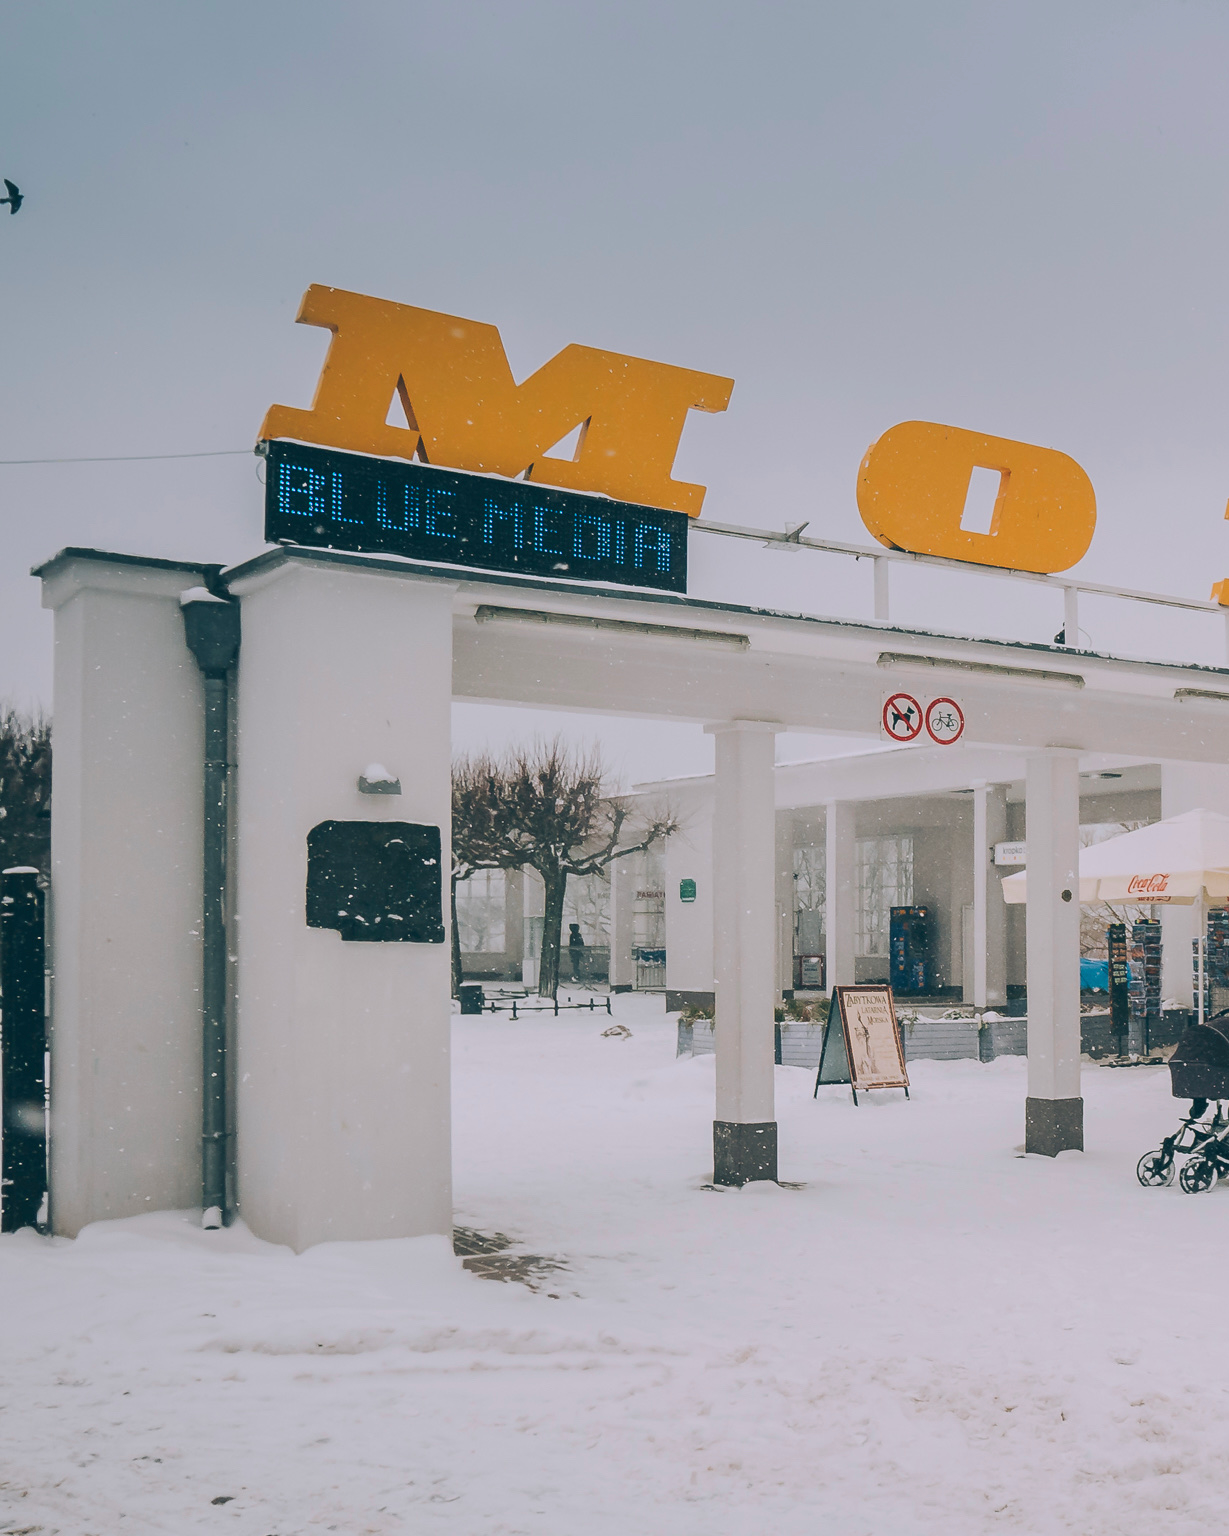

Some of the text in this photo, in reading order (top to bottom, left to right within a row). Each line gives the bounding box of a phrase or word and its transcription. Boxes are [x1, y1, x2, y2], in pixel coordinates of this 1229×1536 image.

[278, 463, 670, 572] BLUE MEDIA
[845, 993, 887, 1008] ZABYTKOWA
